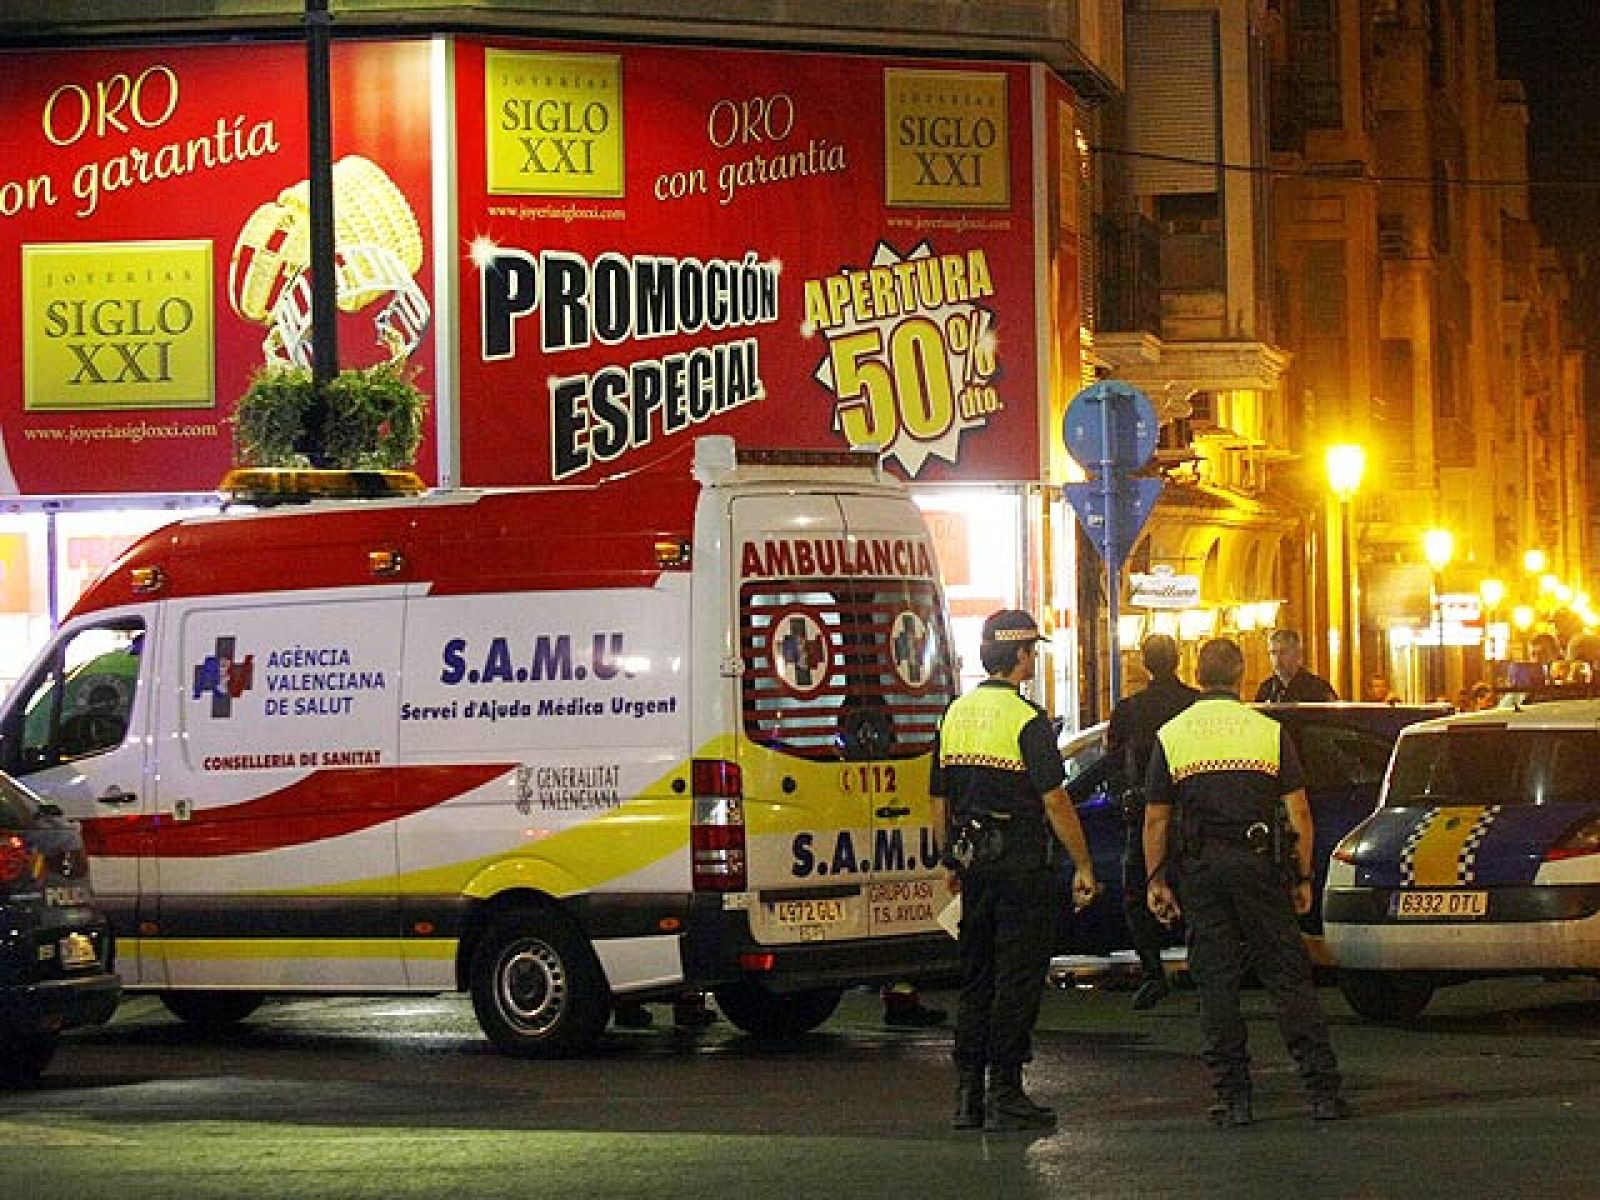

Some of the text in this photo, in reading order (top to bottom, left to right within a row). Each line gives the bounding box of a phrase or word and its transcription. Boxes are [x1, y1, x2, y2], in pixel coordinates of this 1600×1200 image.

[42, 64, 179, 146] ORO
[502, 98, 609, 134] SIGLO
[708, 94, 794, 148] ORO
[900, 115, 996, 148] SIGLO
[0, 113, 281, 219] on garantía
[519, 136, 596, 176] XXI
[654, 138, 846, 206] con garantía
[914, 152, 983, 189] XXI
[481, 247, 779, 361] PROMOCIÓN
[804, 249, 995, 333] APERTURA
[44, 296, 195, 338] SIGLO
[66, 341, 174, 384] XXI
[550, 338, 764, 481] ESPECIAL
[741, 539, 933, 578] AMBULANCIA
[440, 632, 636, 686] S.A.M.U.
[266, 672, 386, 691] VALENCIANA
[264, 697, 354, 716] DE SALUT
[401, 702, 458, 720] Servei
[611, 696, 676, 718] Urgent
[204, 750, 382, 771] CONSELLERIA DE SANITAT
[536, 764, 621, 789] GENERALITAT
[859, 766, 897, 793] 112
[538, 788, 621, 811] VALENCIANA
[1401, 894, 1442, 914] 6332
